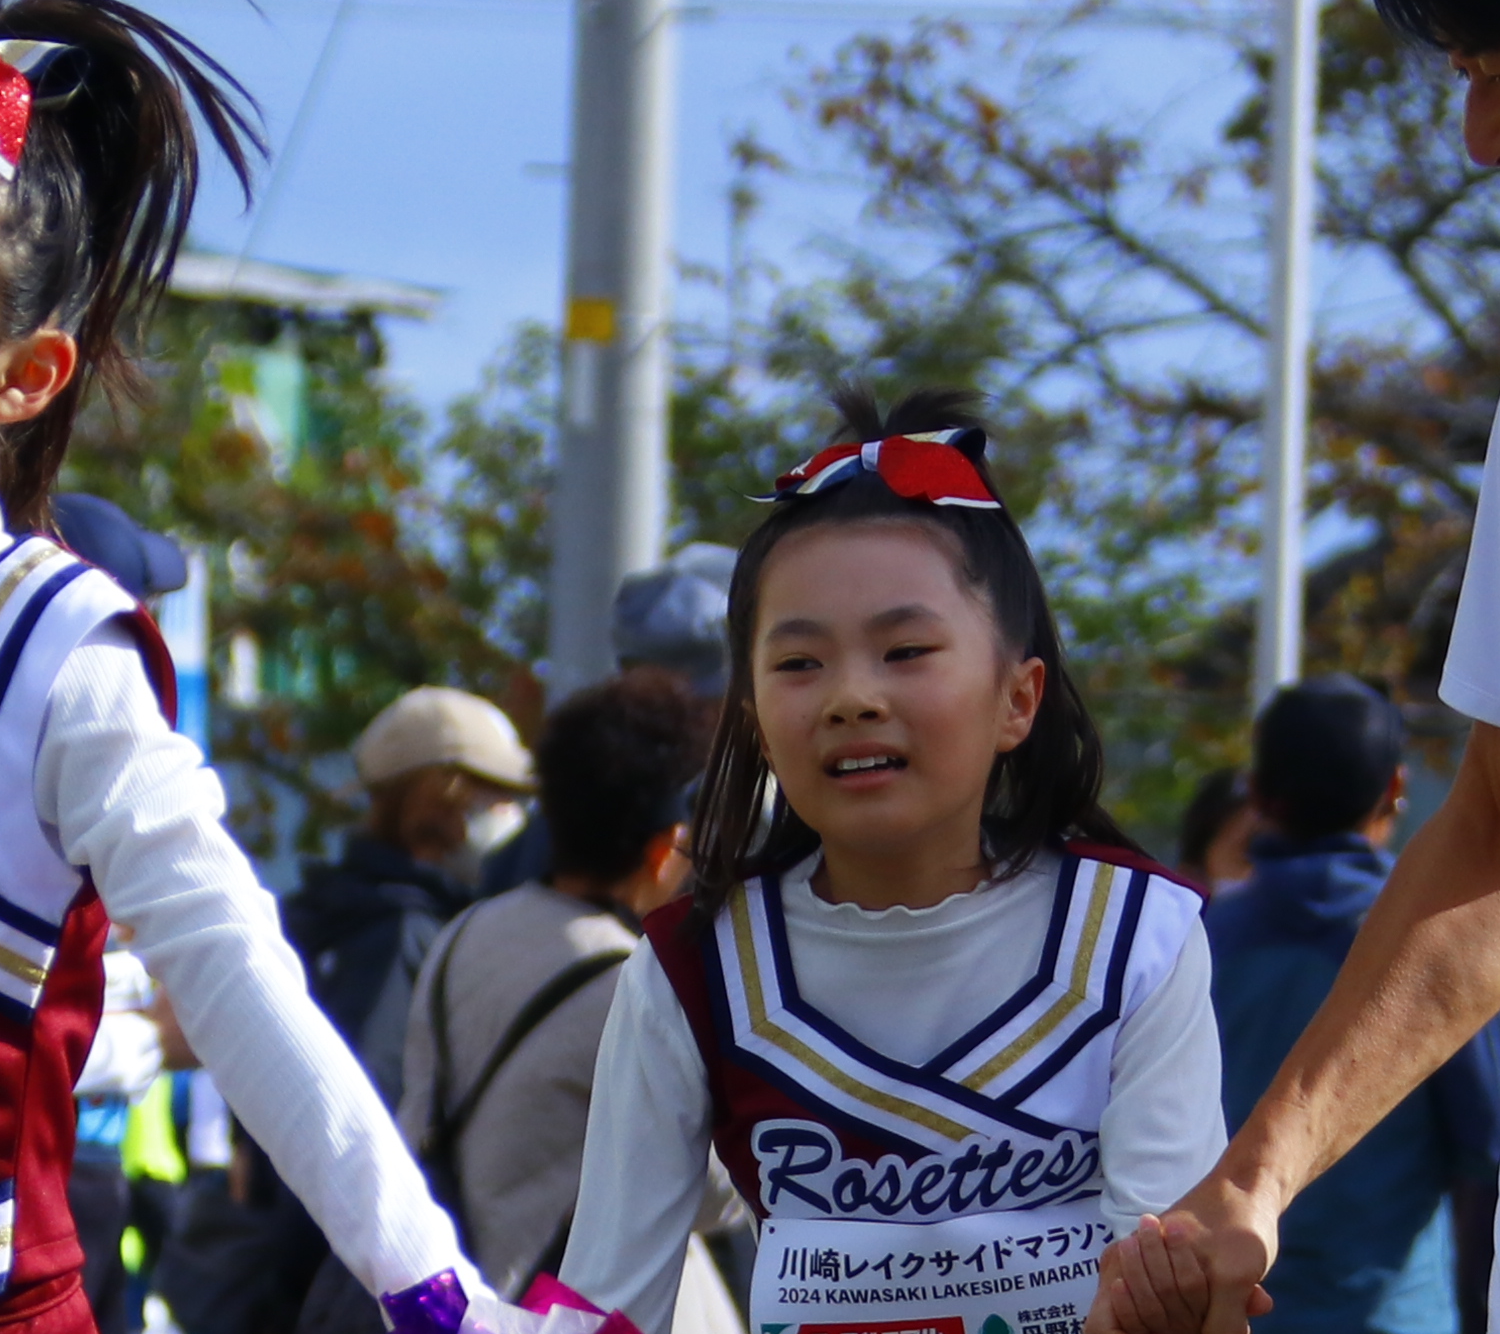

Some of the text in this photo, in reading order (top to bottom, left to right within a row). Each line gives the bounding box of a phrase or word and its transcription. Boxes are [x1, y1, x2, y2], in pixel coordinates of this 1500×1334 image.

[758, 1127, 1099, 1217] Rosettes
[778, 1257, 1100, 1305] 2024 KAWASAKI LAKESIDE MARAT
[1018, 1302, 1076, 1323] 株式会社
